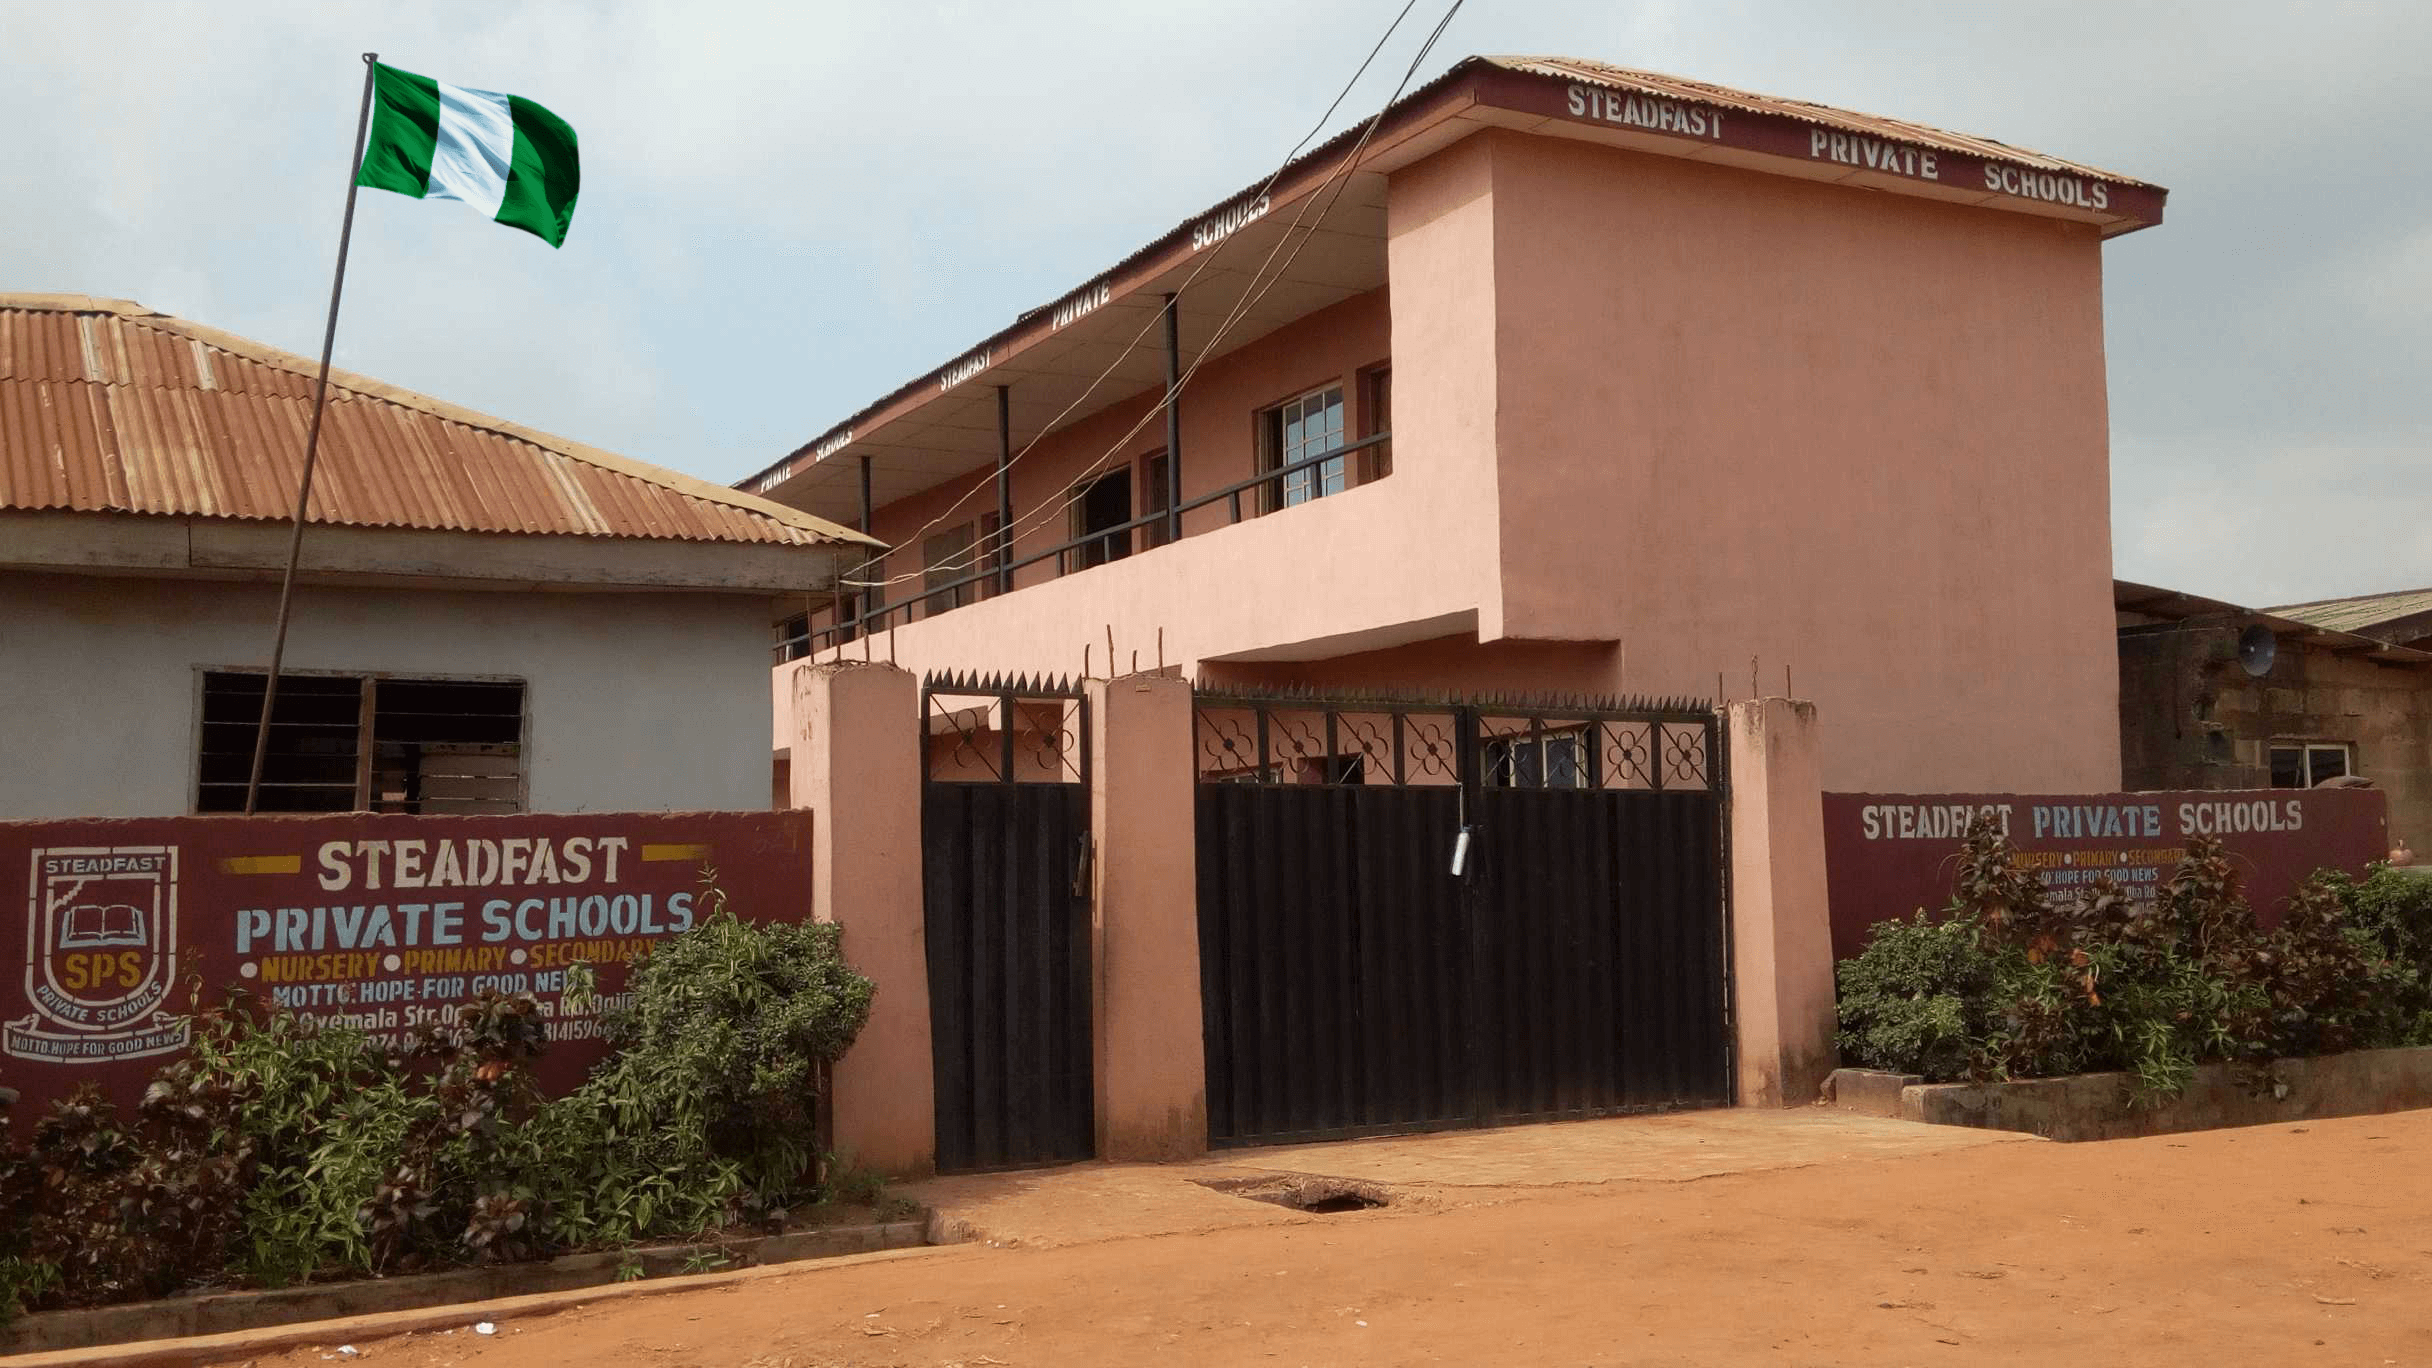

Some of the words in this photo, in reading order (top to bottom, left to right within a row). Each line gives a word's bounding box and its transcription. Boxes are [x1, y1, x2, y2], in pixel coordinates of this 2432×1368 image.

[1567, 84, 1725, 139] STEADFAST
[1810, 128, 1939, 180] PRIVATE
[1983, 162, 2109, 210] SCHOOLS
[940, 349, 992, 392] STEADFAST
[1052, 279, 1111, 331] PRIVATE
[1192, 194, 1271, 252] SCHOOLS
[815, 430, 853, 463] SCHOOLS
[2032, 804, 2161, 838] PRIVATE
[2179, 800, 2303, 834] SCHOOLS
[45, 856, 166, 874] STEADFAST
[317, 836, 628, 892] STEADFAST
[2055, 870, 2080, 885] HOPE
[2131, 866, 2159, 882] NEWS
[2072, 850, 2118, 867] PRIMARY
[236, 902, 465, 954] PRIVATE
[481, 892, 693, 942] SCHOOLS
[64, 951, 142, 989] SPS
[261, 951, 381, 983] NURSERY
[404, 946, 507, 975] PRIMARY
[36, 983, 89, 1022] PRIVATE
[97, 979, 163, 1022] SCHOOLS
[360, 979, 416, 1004] HOPE
[423, 976, 465, 999] FOR
[50, 1040, 81, 1055] HOPE
[82, 1041, 105, 1055] FOR
[108, 1037, 143, 1054] GOOD
[146, 1032, 183, 1049] NEWS
